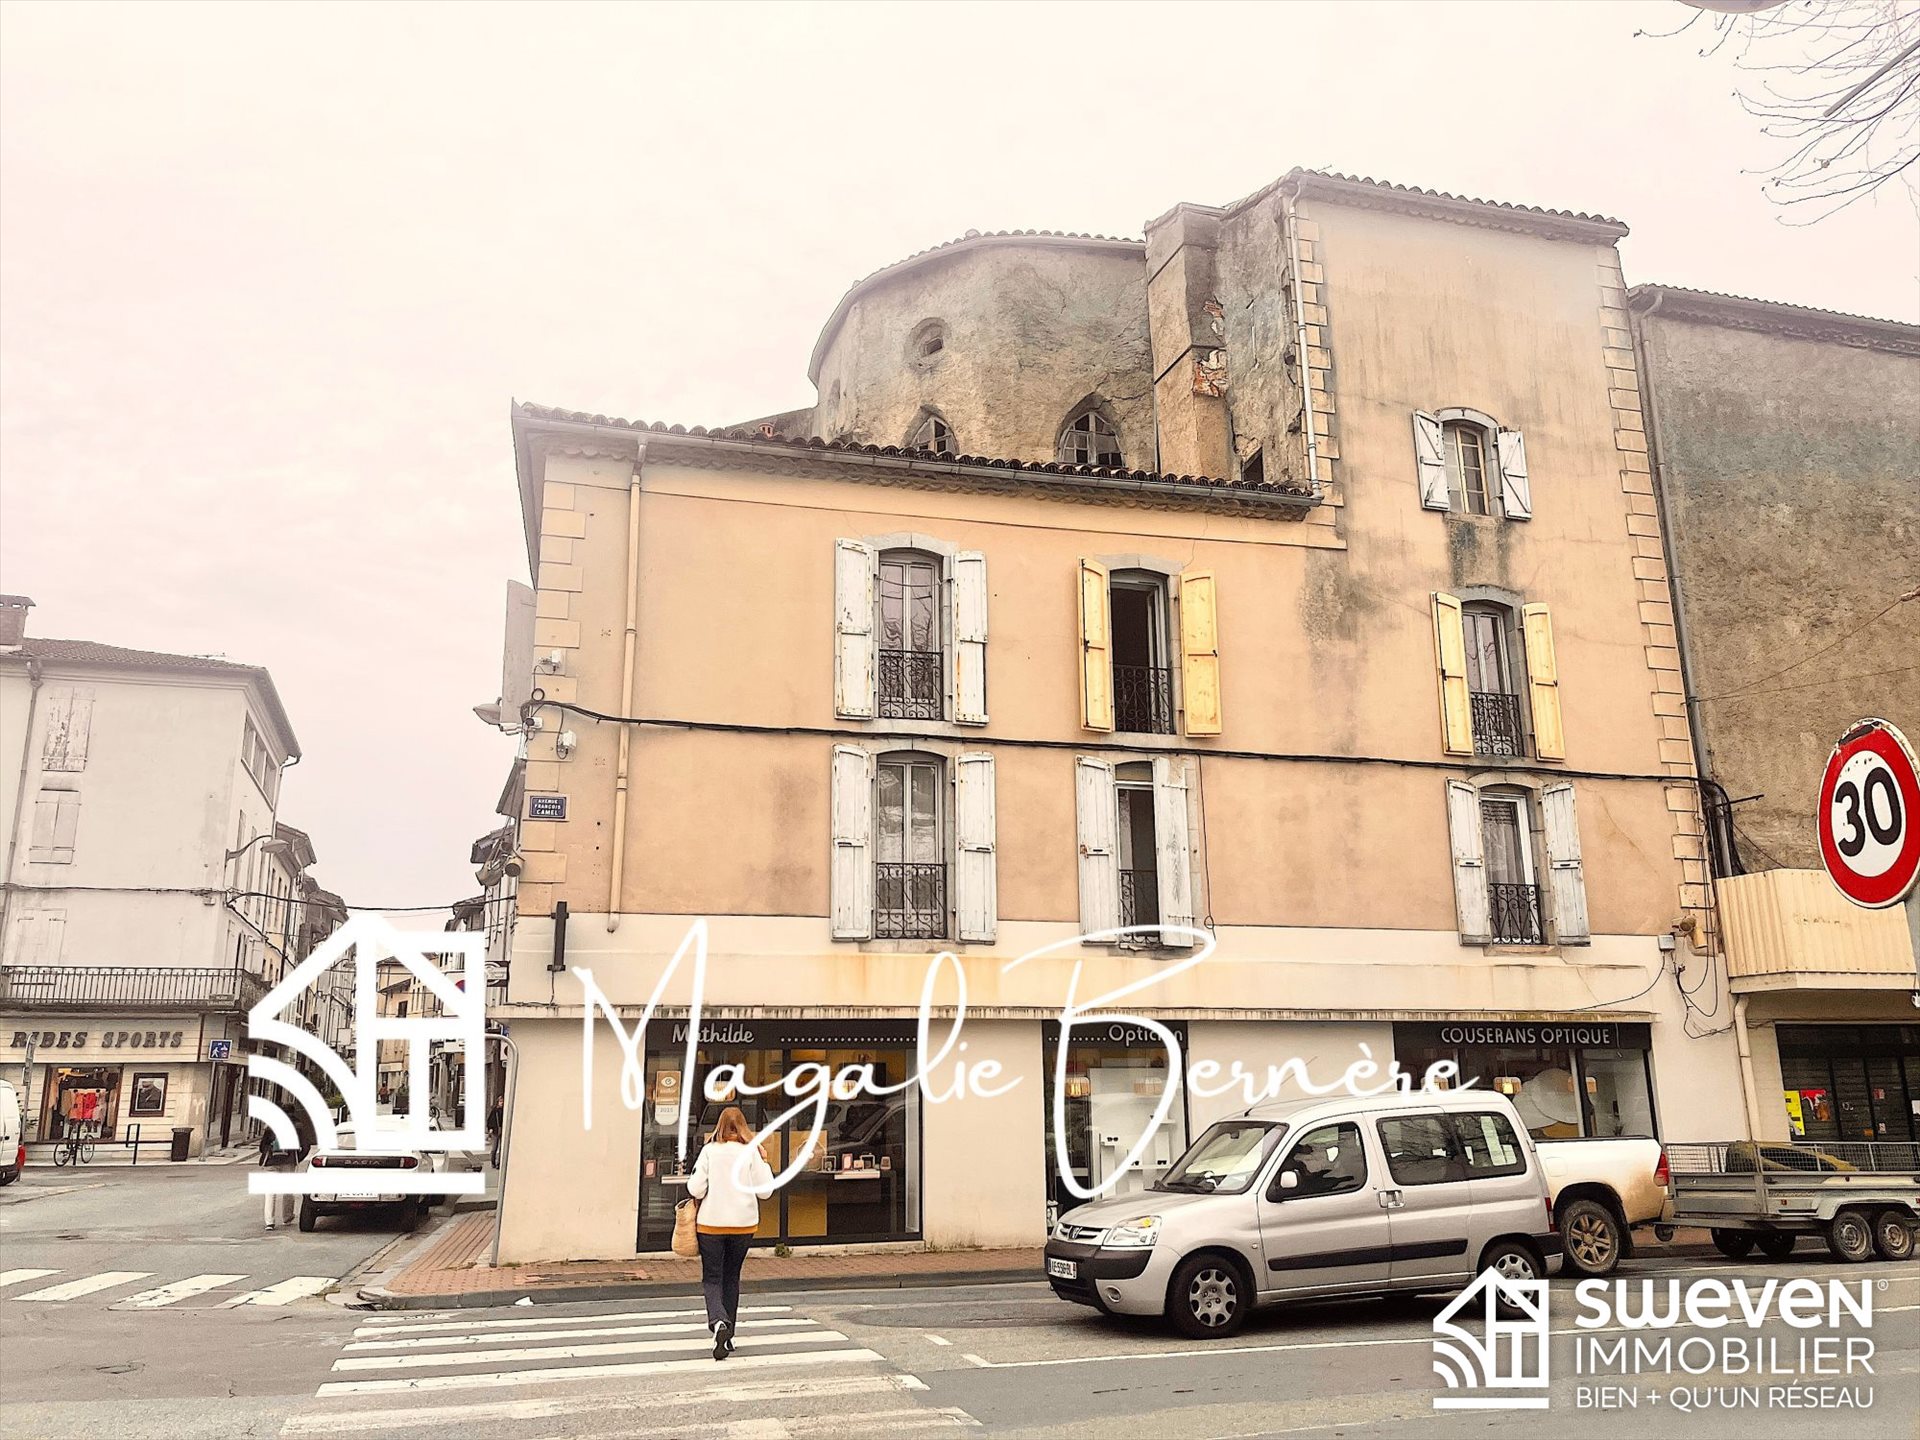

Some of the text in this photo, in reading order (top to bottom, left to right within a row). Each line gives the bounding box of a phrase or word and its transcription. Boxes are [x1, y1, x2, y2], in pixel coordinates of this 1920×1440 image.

[1834, 766, 1902, 858] 30
[101, 1031, 183, 1048] SPORTS
[672, 1022, 754, 1043] Mthilde
[1109, 1024, 1183, 1047] Opticn
[1441, 1027, 1611, 1045] COUSERANS OPTIQUE
